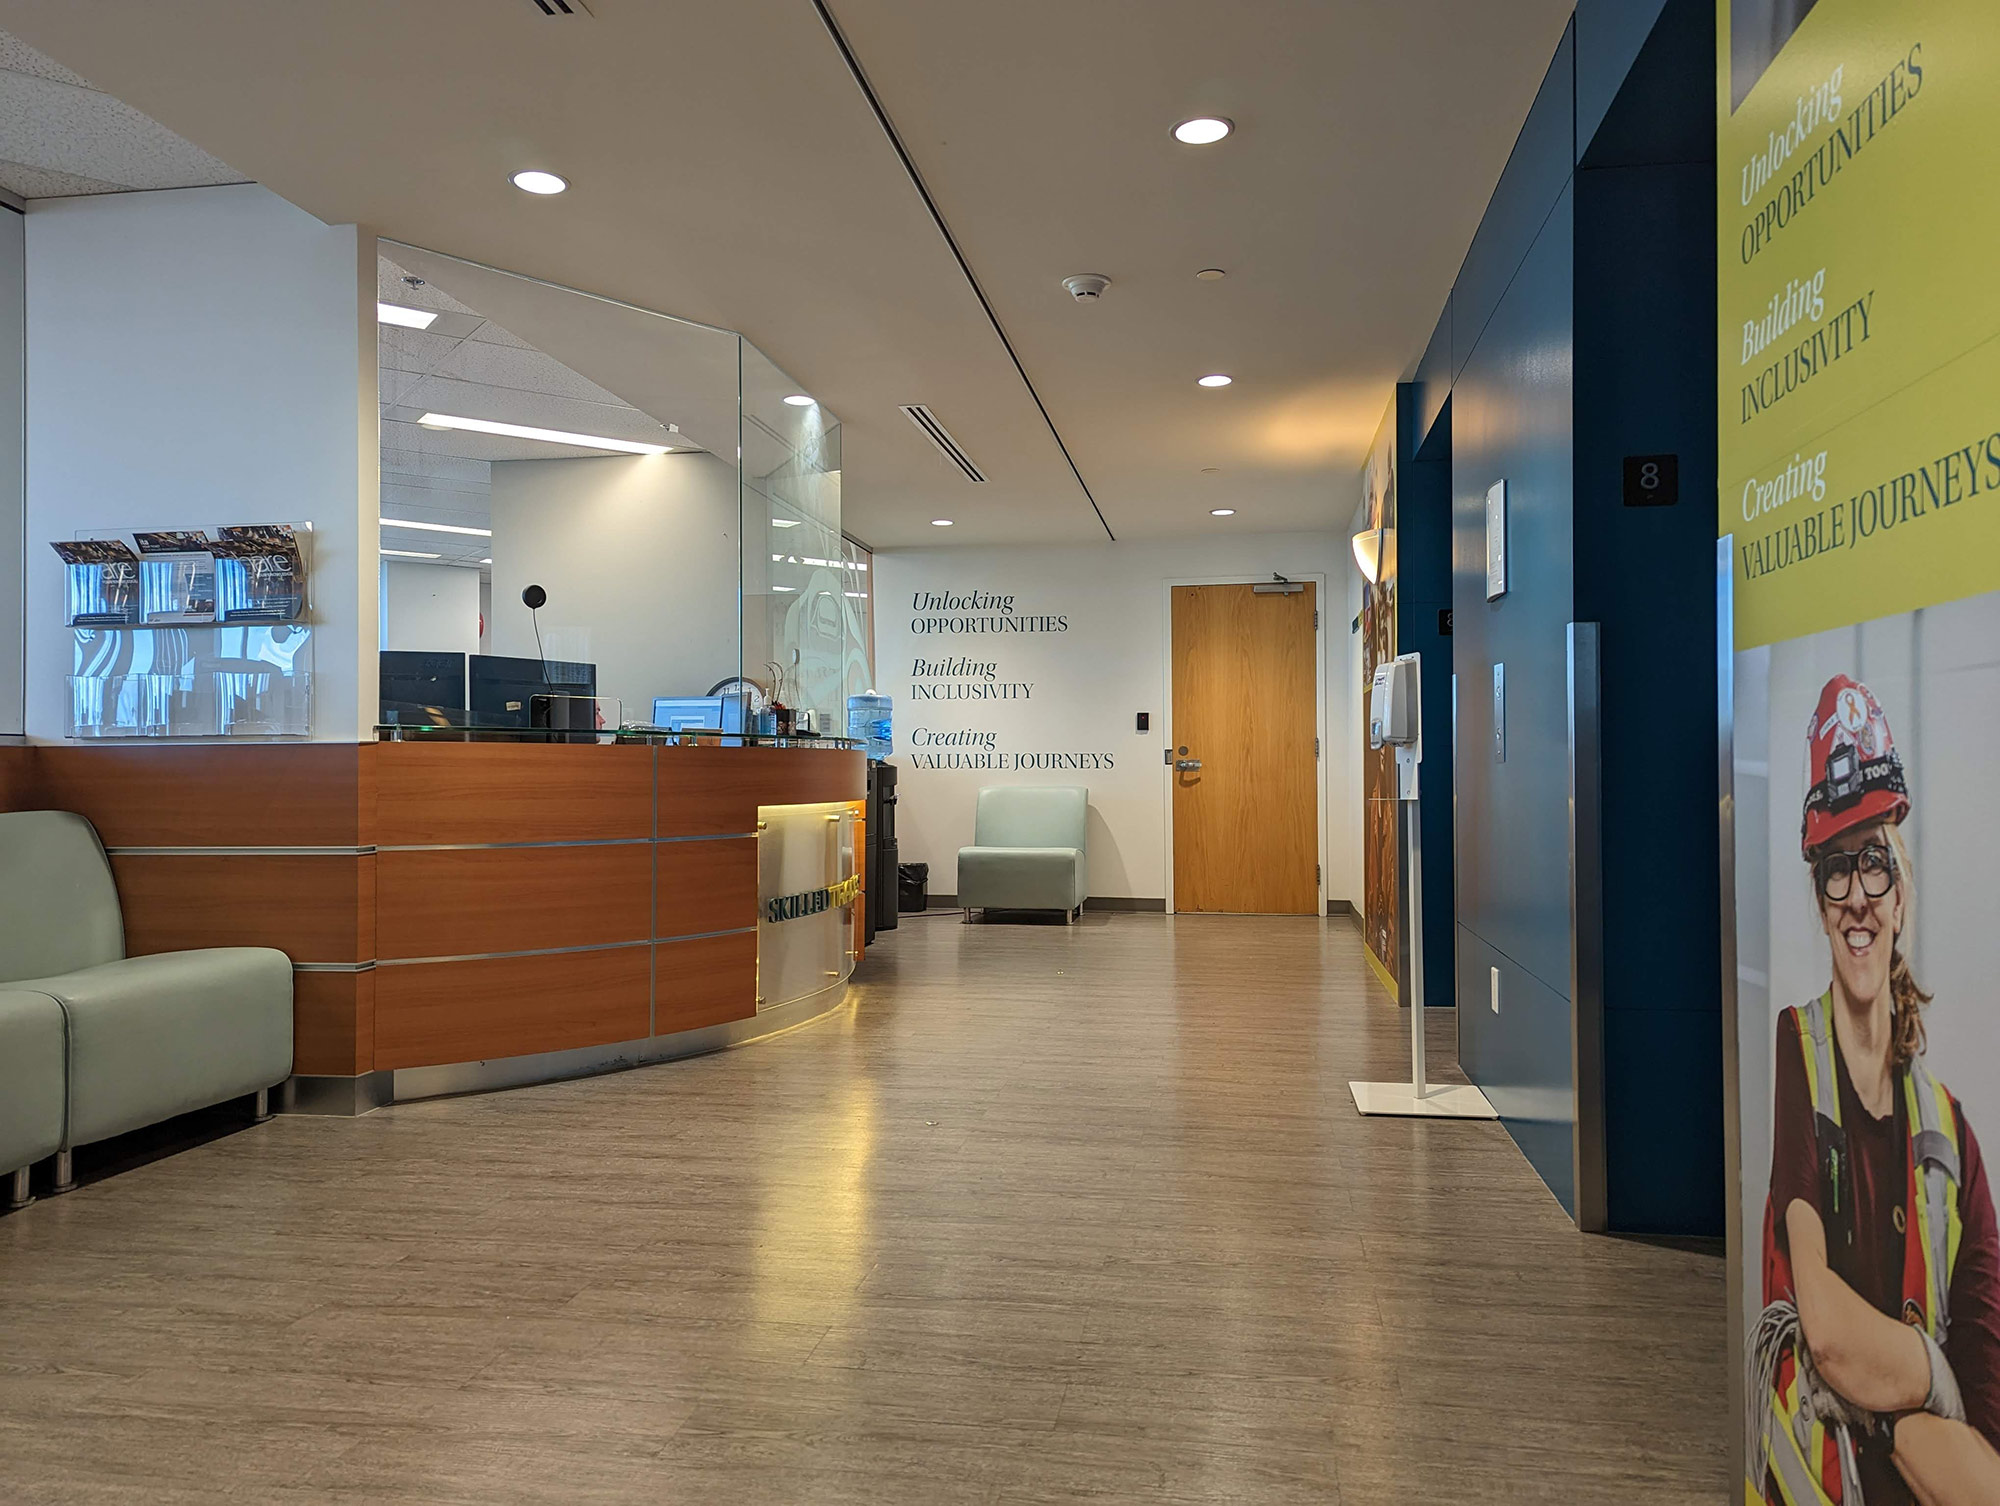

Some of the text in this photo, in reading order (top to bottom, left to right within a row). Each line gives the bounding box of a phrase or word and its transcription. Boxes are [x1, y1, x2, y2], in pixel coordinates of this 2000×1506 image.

[1741, 63, 1844, 207] Unlocking
[1741, 42, 1923, 265] OPPORTUNITIES
[1741, 267, 1826, 366] Building
[1741, 290, 1875, 425] INCLUSIVITY
[1641, 462, 1660, 490] 8
[1742, 450, 1828, 522] Creating
[1741, 432, 2000, 581] VALUABLE JOURNEYS
[912, 590, 1015, 615] Unlocking
[910, 615, 1068, 635] OPPORTUNITIES
[911, 657, 997, 681] Building
[911, 683, 1034, 700] INCLUSIVITY
[912, 727, 997, 751] Creating
[910, 752, 1114, 771] VALUABLE JOURNEYS
